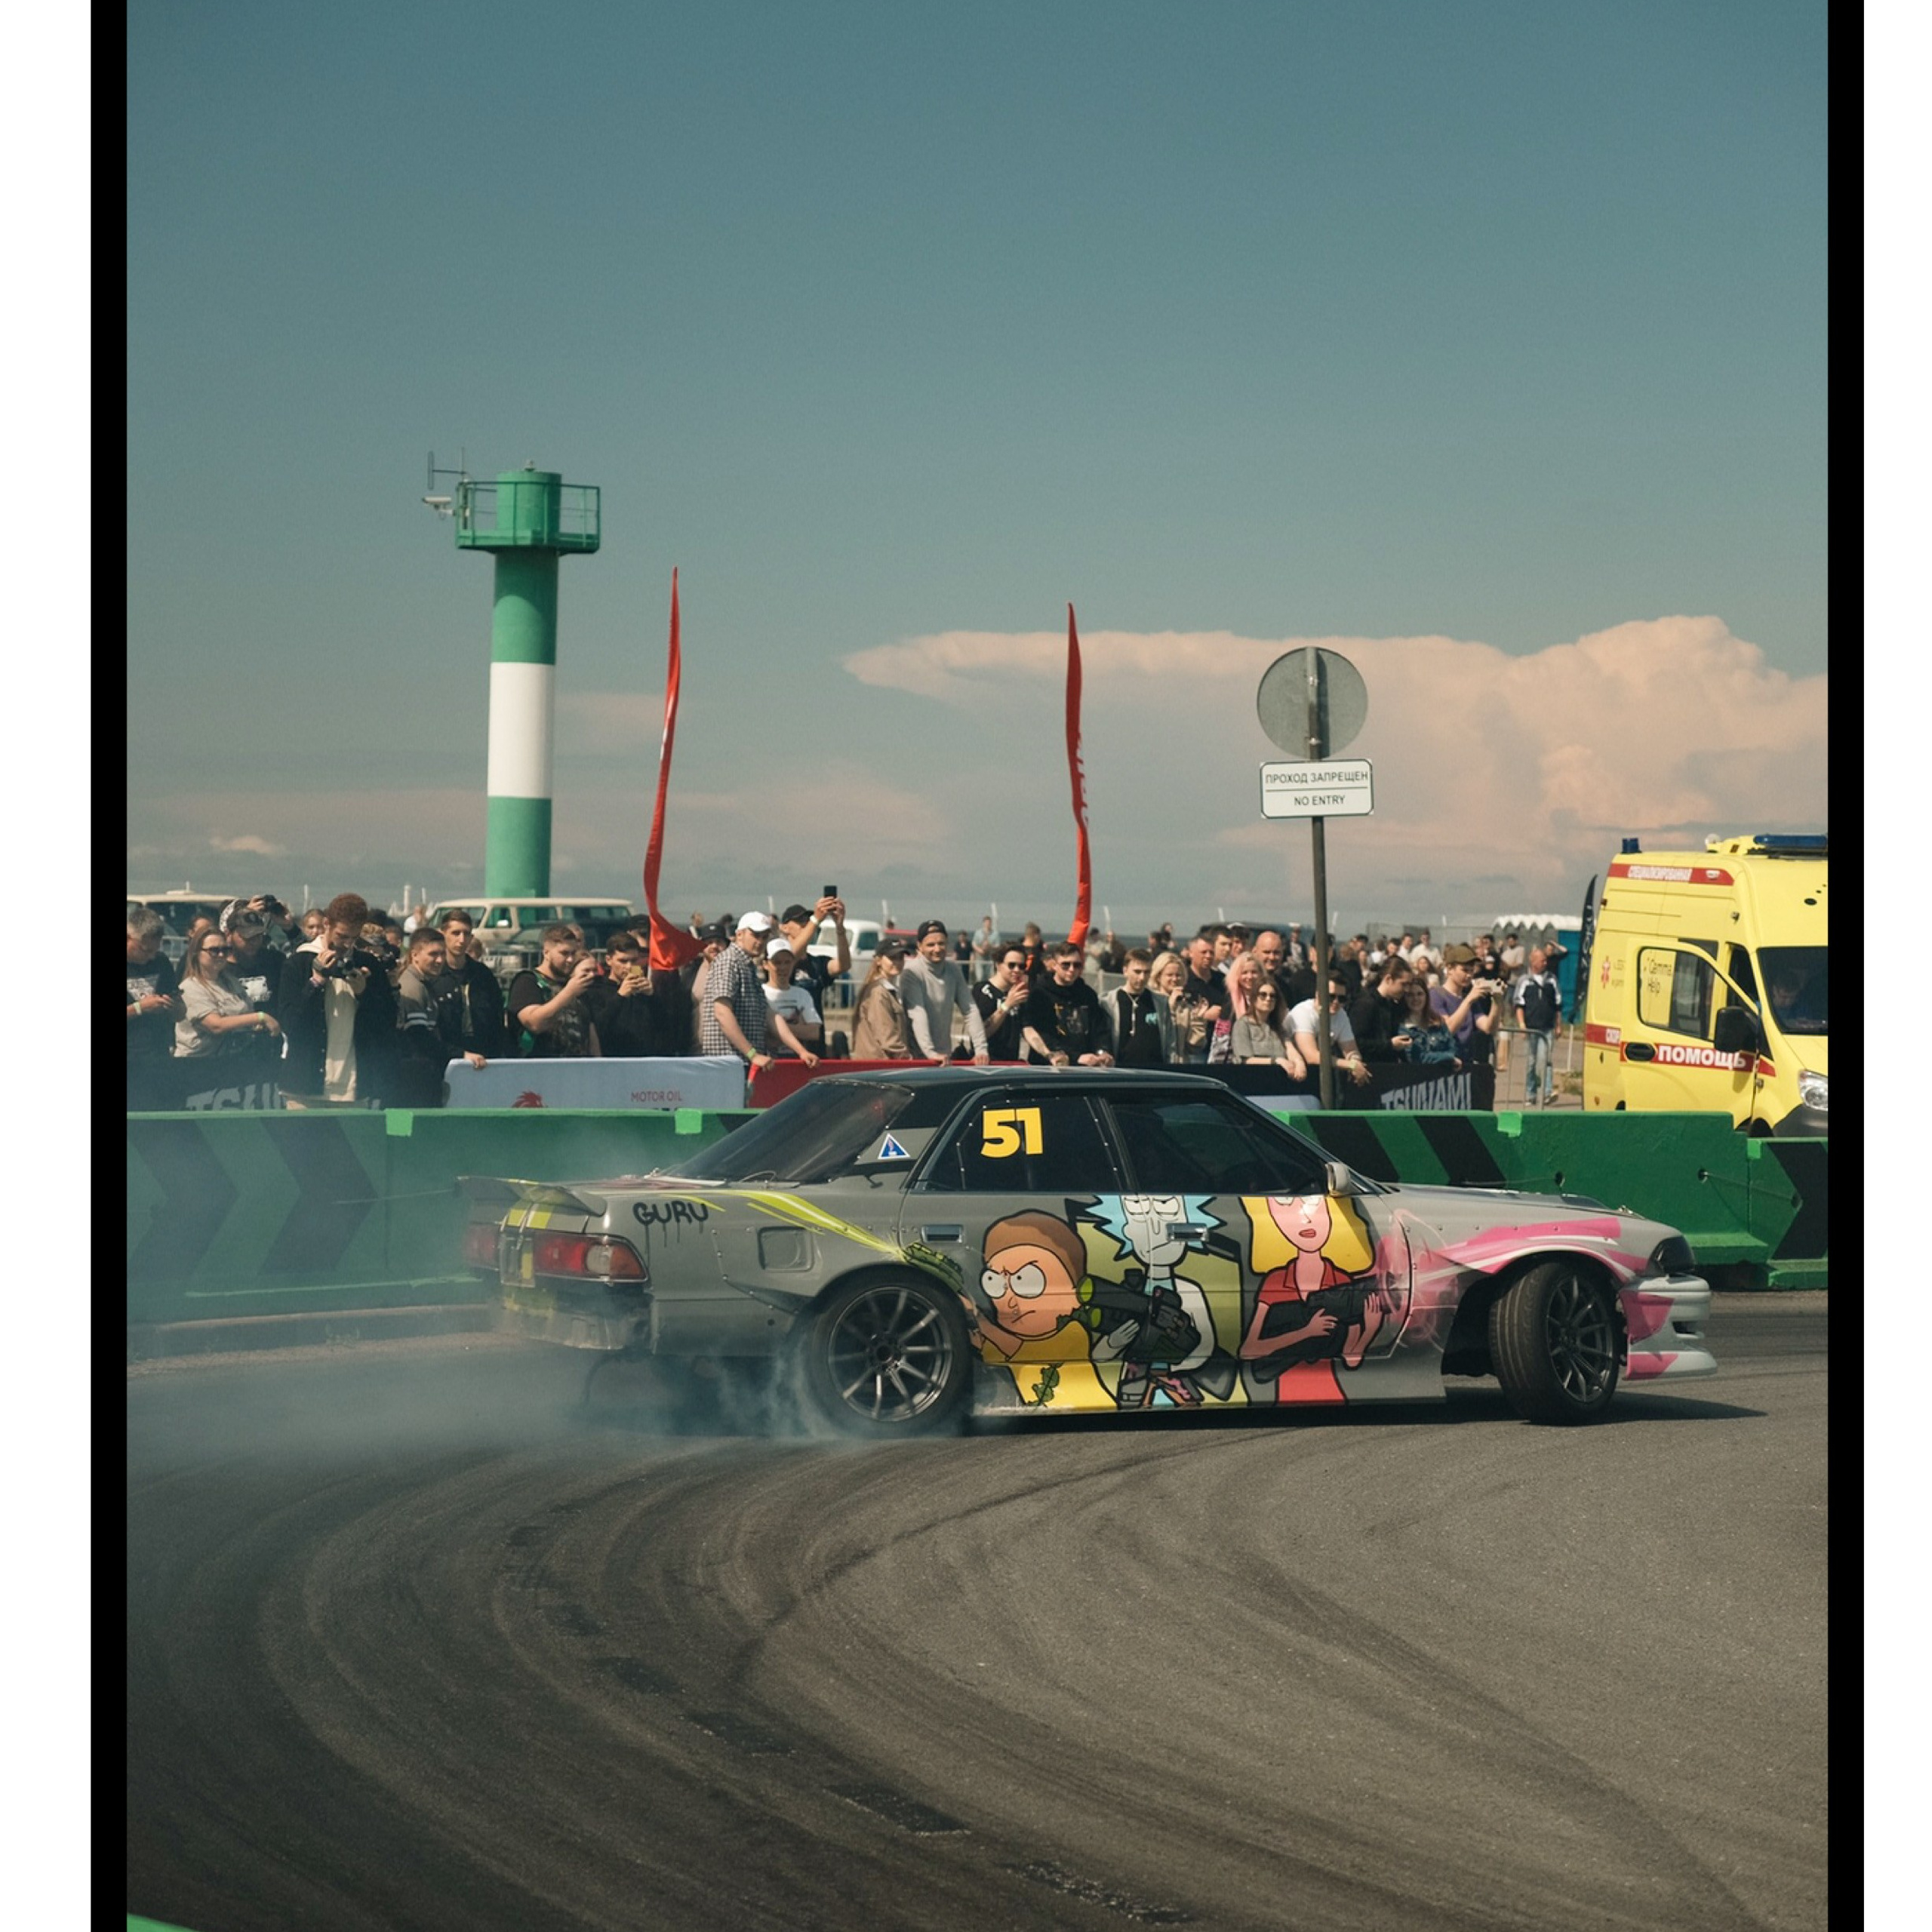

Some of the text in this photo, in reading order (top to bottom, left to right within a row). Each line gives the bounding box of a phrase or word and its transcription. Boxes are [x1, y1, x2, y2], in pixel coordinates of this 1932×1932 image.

[1265, 771, 1368, 784] ПРОХОД ЗАПРЕЩЕН
[1294, 795, 1346, 806] NO ENTRY
[1657, 1045, 1747, 1070] ПОМОЩЬ
[630, 1090, 683, 1103] MOTOR OIL
[1380, 1072, 1472, 1110] TSUNAMI
[981, 1107, 1043, 1158] 51
[632, 1200, 709, 1225] GURU
